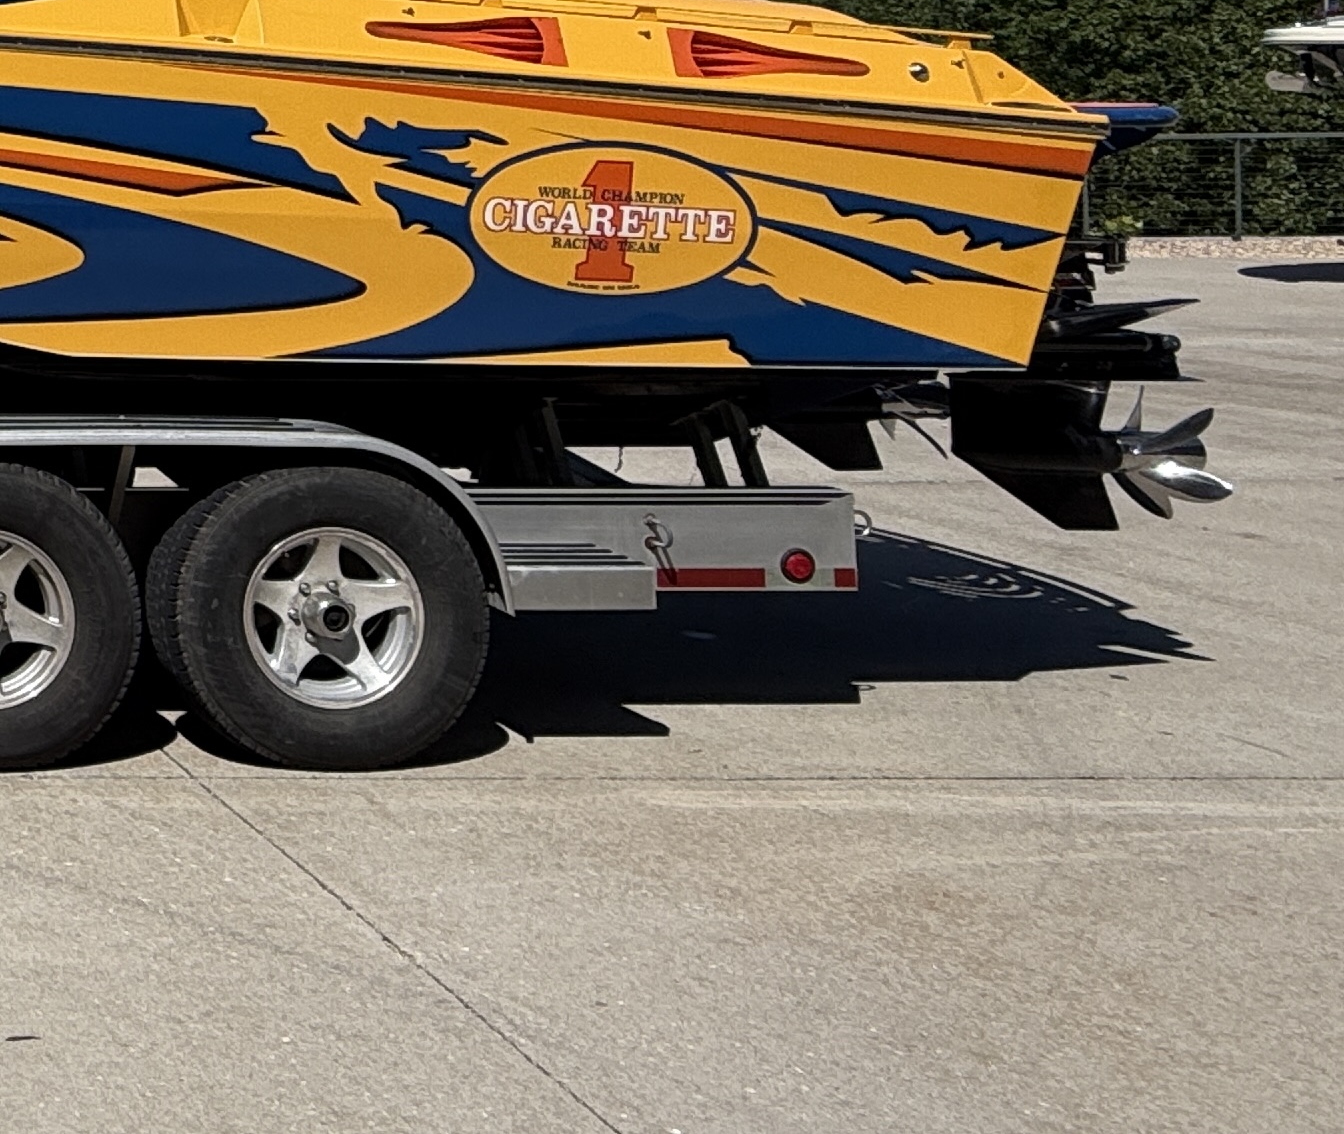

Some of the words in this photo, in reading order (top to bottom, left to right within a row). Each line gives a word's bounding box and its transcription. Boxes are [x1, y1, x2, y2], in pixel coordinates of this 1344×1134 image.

[538, 186, 593, 201] WORLD
[601, 189, 685, 204] CHAMPION
[483, 196, 737, 244] CIGARETTE
[551, 237, 609, 251] RACING
[617, 240, 661, 254] TEAM
